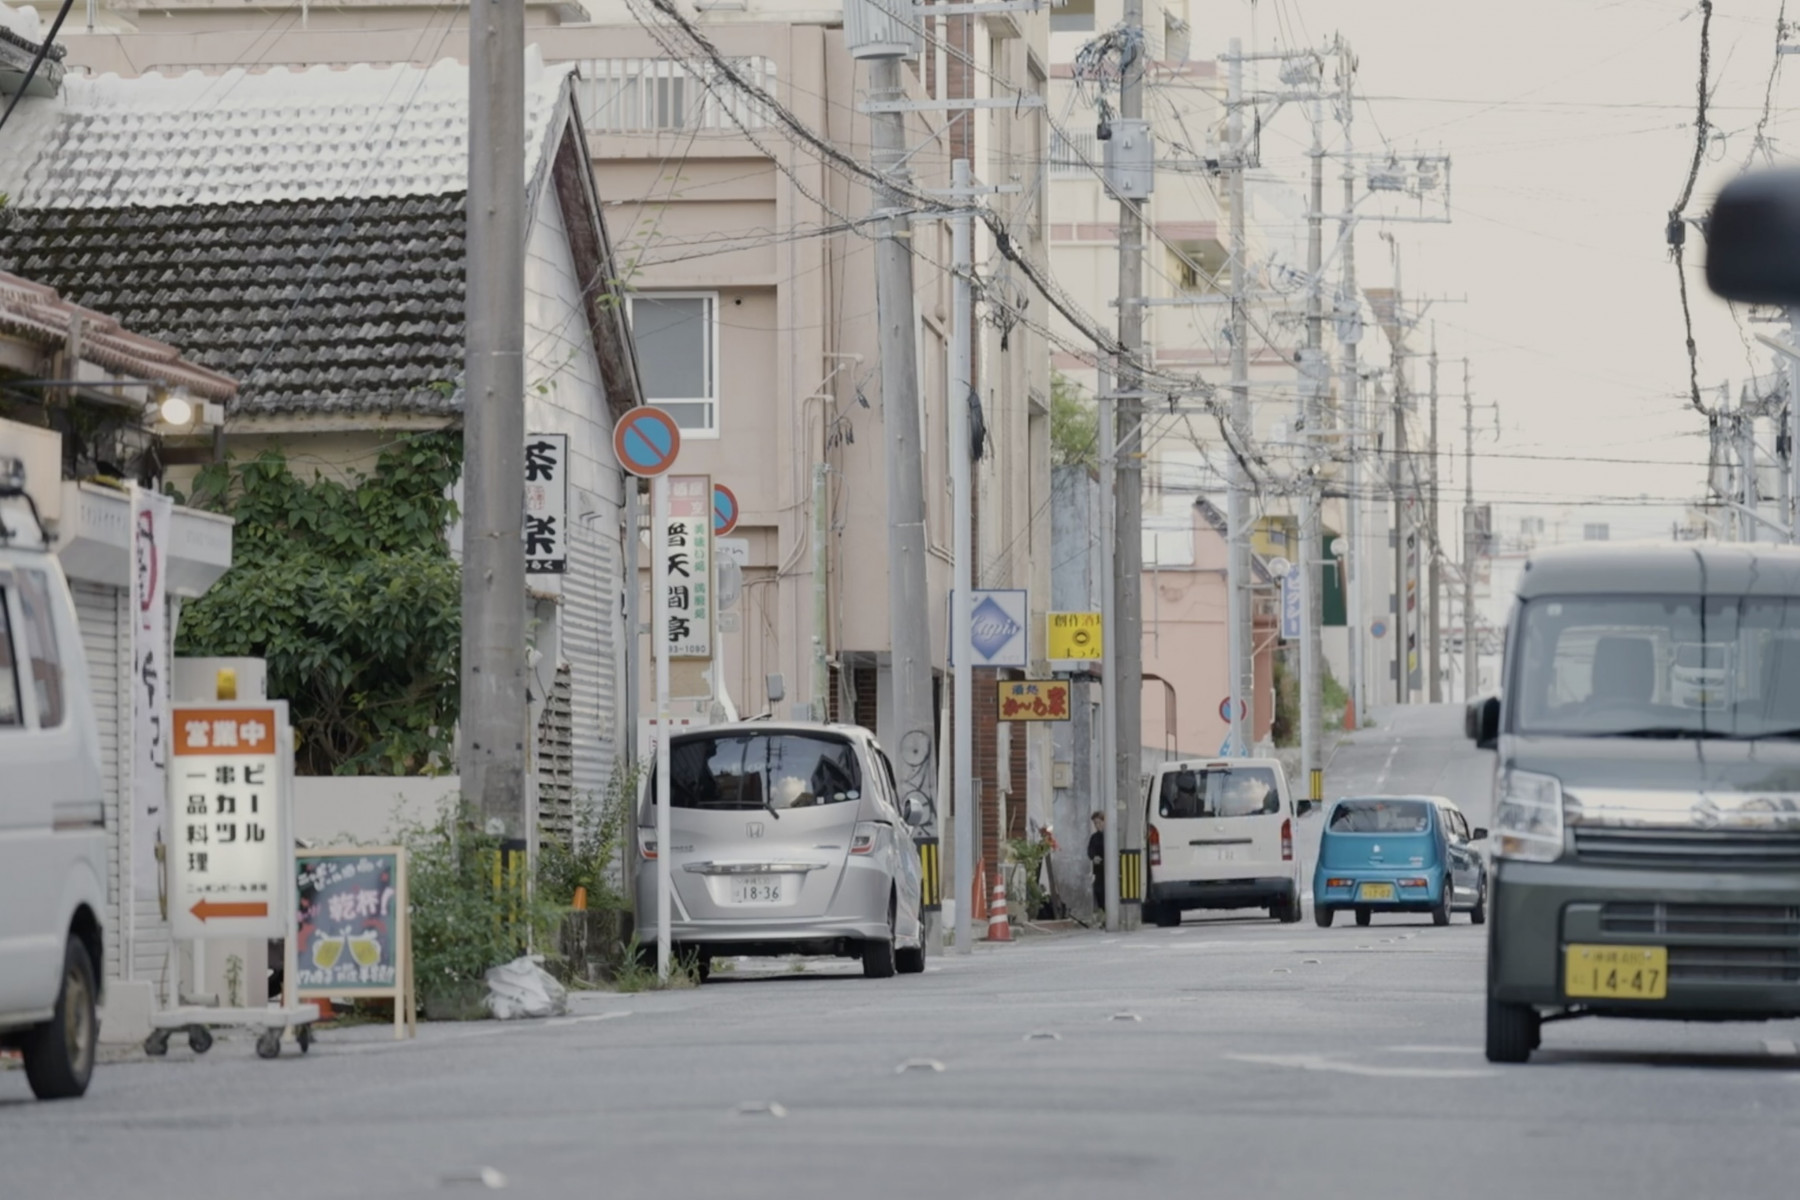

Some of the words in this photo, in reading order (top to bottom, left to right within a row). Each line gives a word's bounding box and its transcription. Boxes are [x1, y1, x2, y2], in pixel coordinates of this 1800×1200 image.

[185, 719, 266, 748] 営業中
[187, 772, 209, 873] 一品料理
[216, 765, 236, 843] 串カツ
[244, 764, 265, 843] ビール
[743, 886, 780, 900] 18-36
[1593, 967, 1660, 994] 14-47
